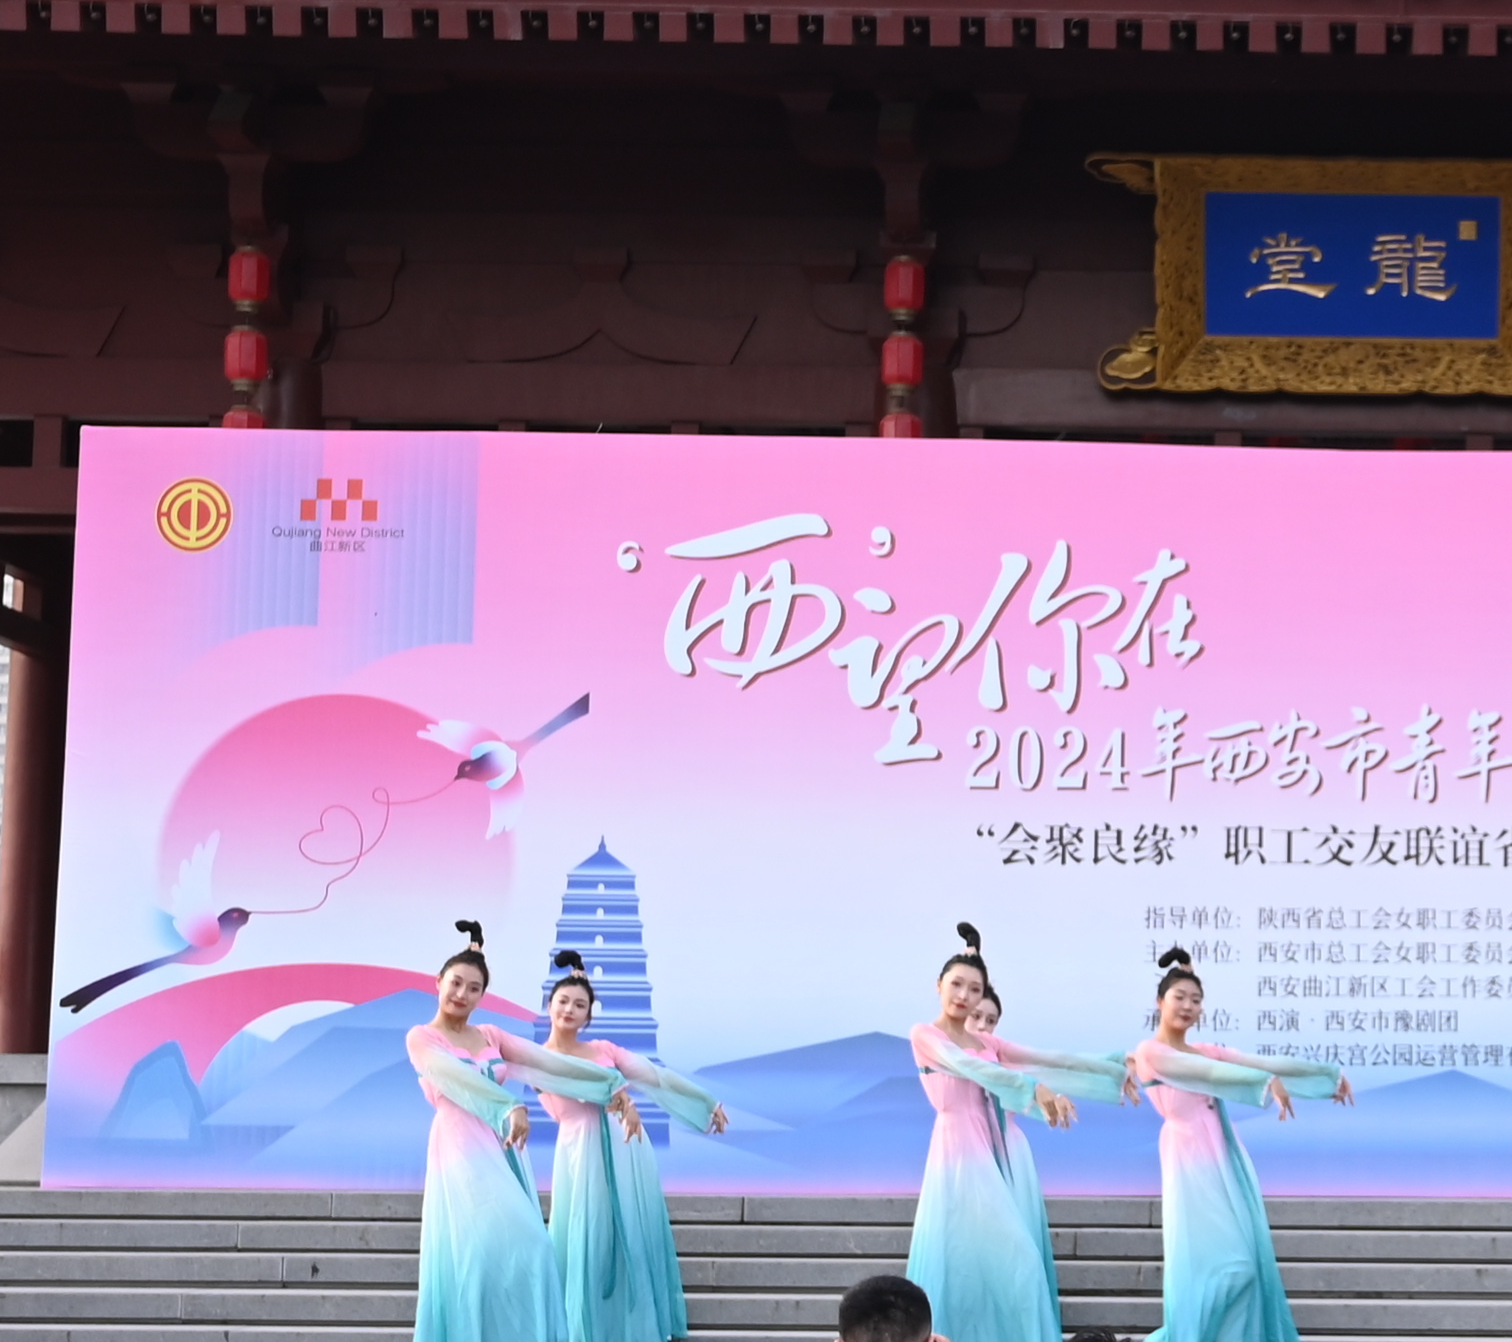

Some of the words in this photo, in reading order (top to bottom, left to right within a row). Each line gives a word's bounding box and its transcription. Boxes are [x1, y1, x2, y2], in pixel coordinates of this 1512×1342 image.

[271, 526, 321, 540] Qujiang
[326, 527, 356, 538] New
[361, 527, 405, 539] District
[309, 540, 366, 553] 曲江新区
